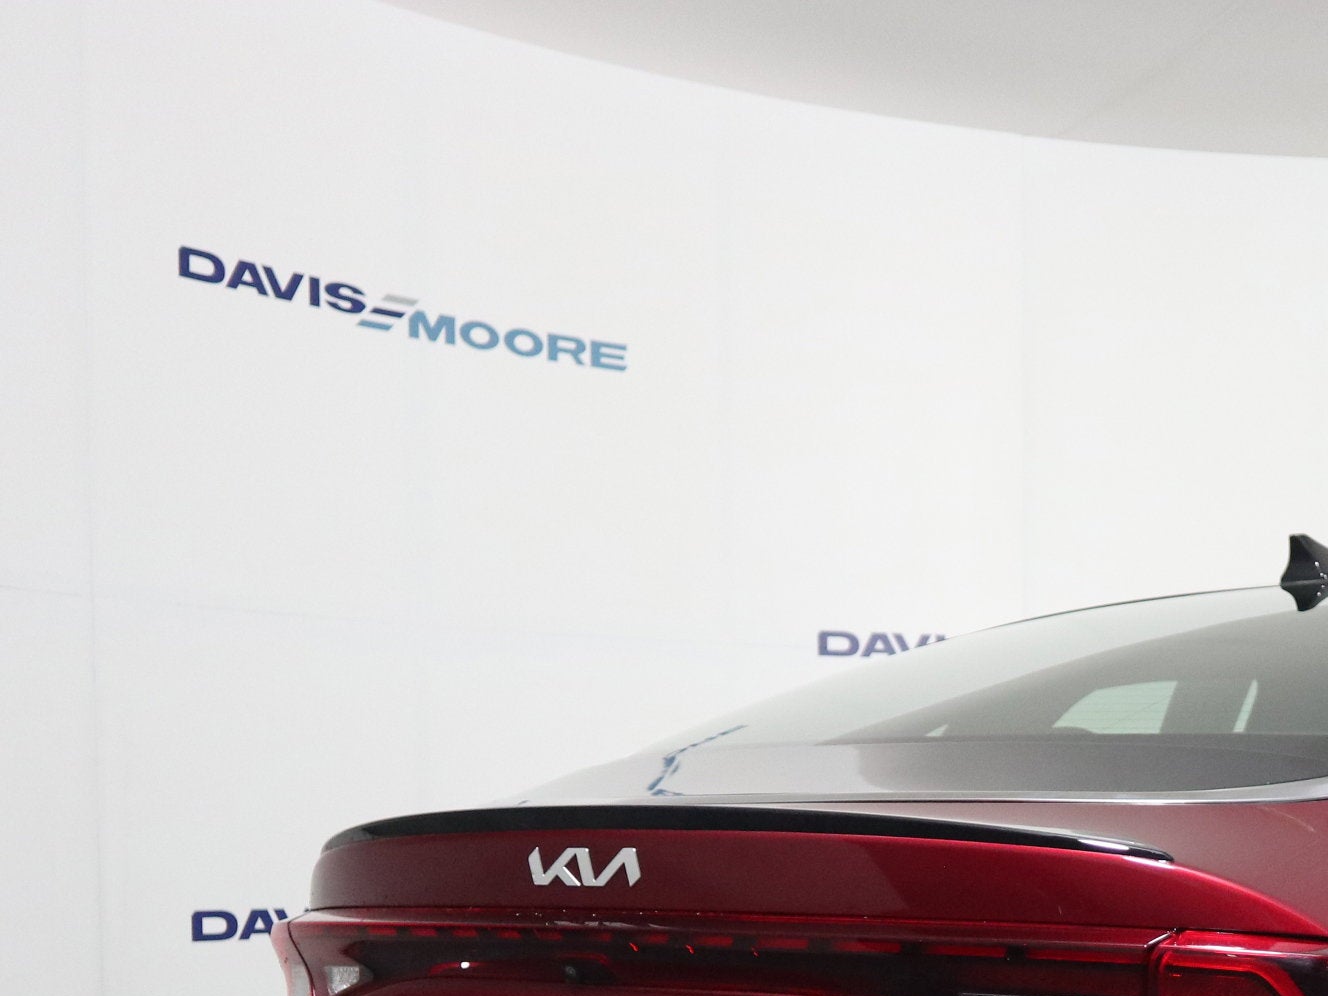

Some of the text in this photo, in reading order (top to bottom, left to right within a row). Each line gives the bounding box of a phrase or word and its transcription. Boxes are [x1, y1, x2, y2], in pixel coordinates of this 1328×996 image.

[178, 245, 628, 372] DAVIS MOORE
[528, 846, 642, 887] KIA
[191, 908, 289, 942] DA
